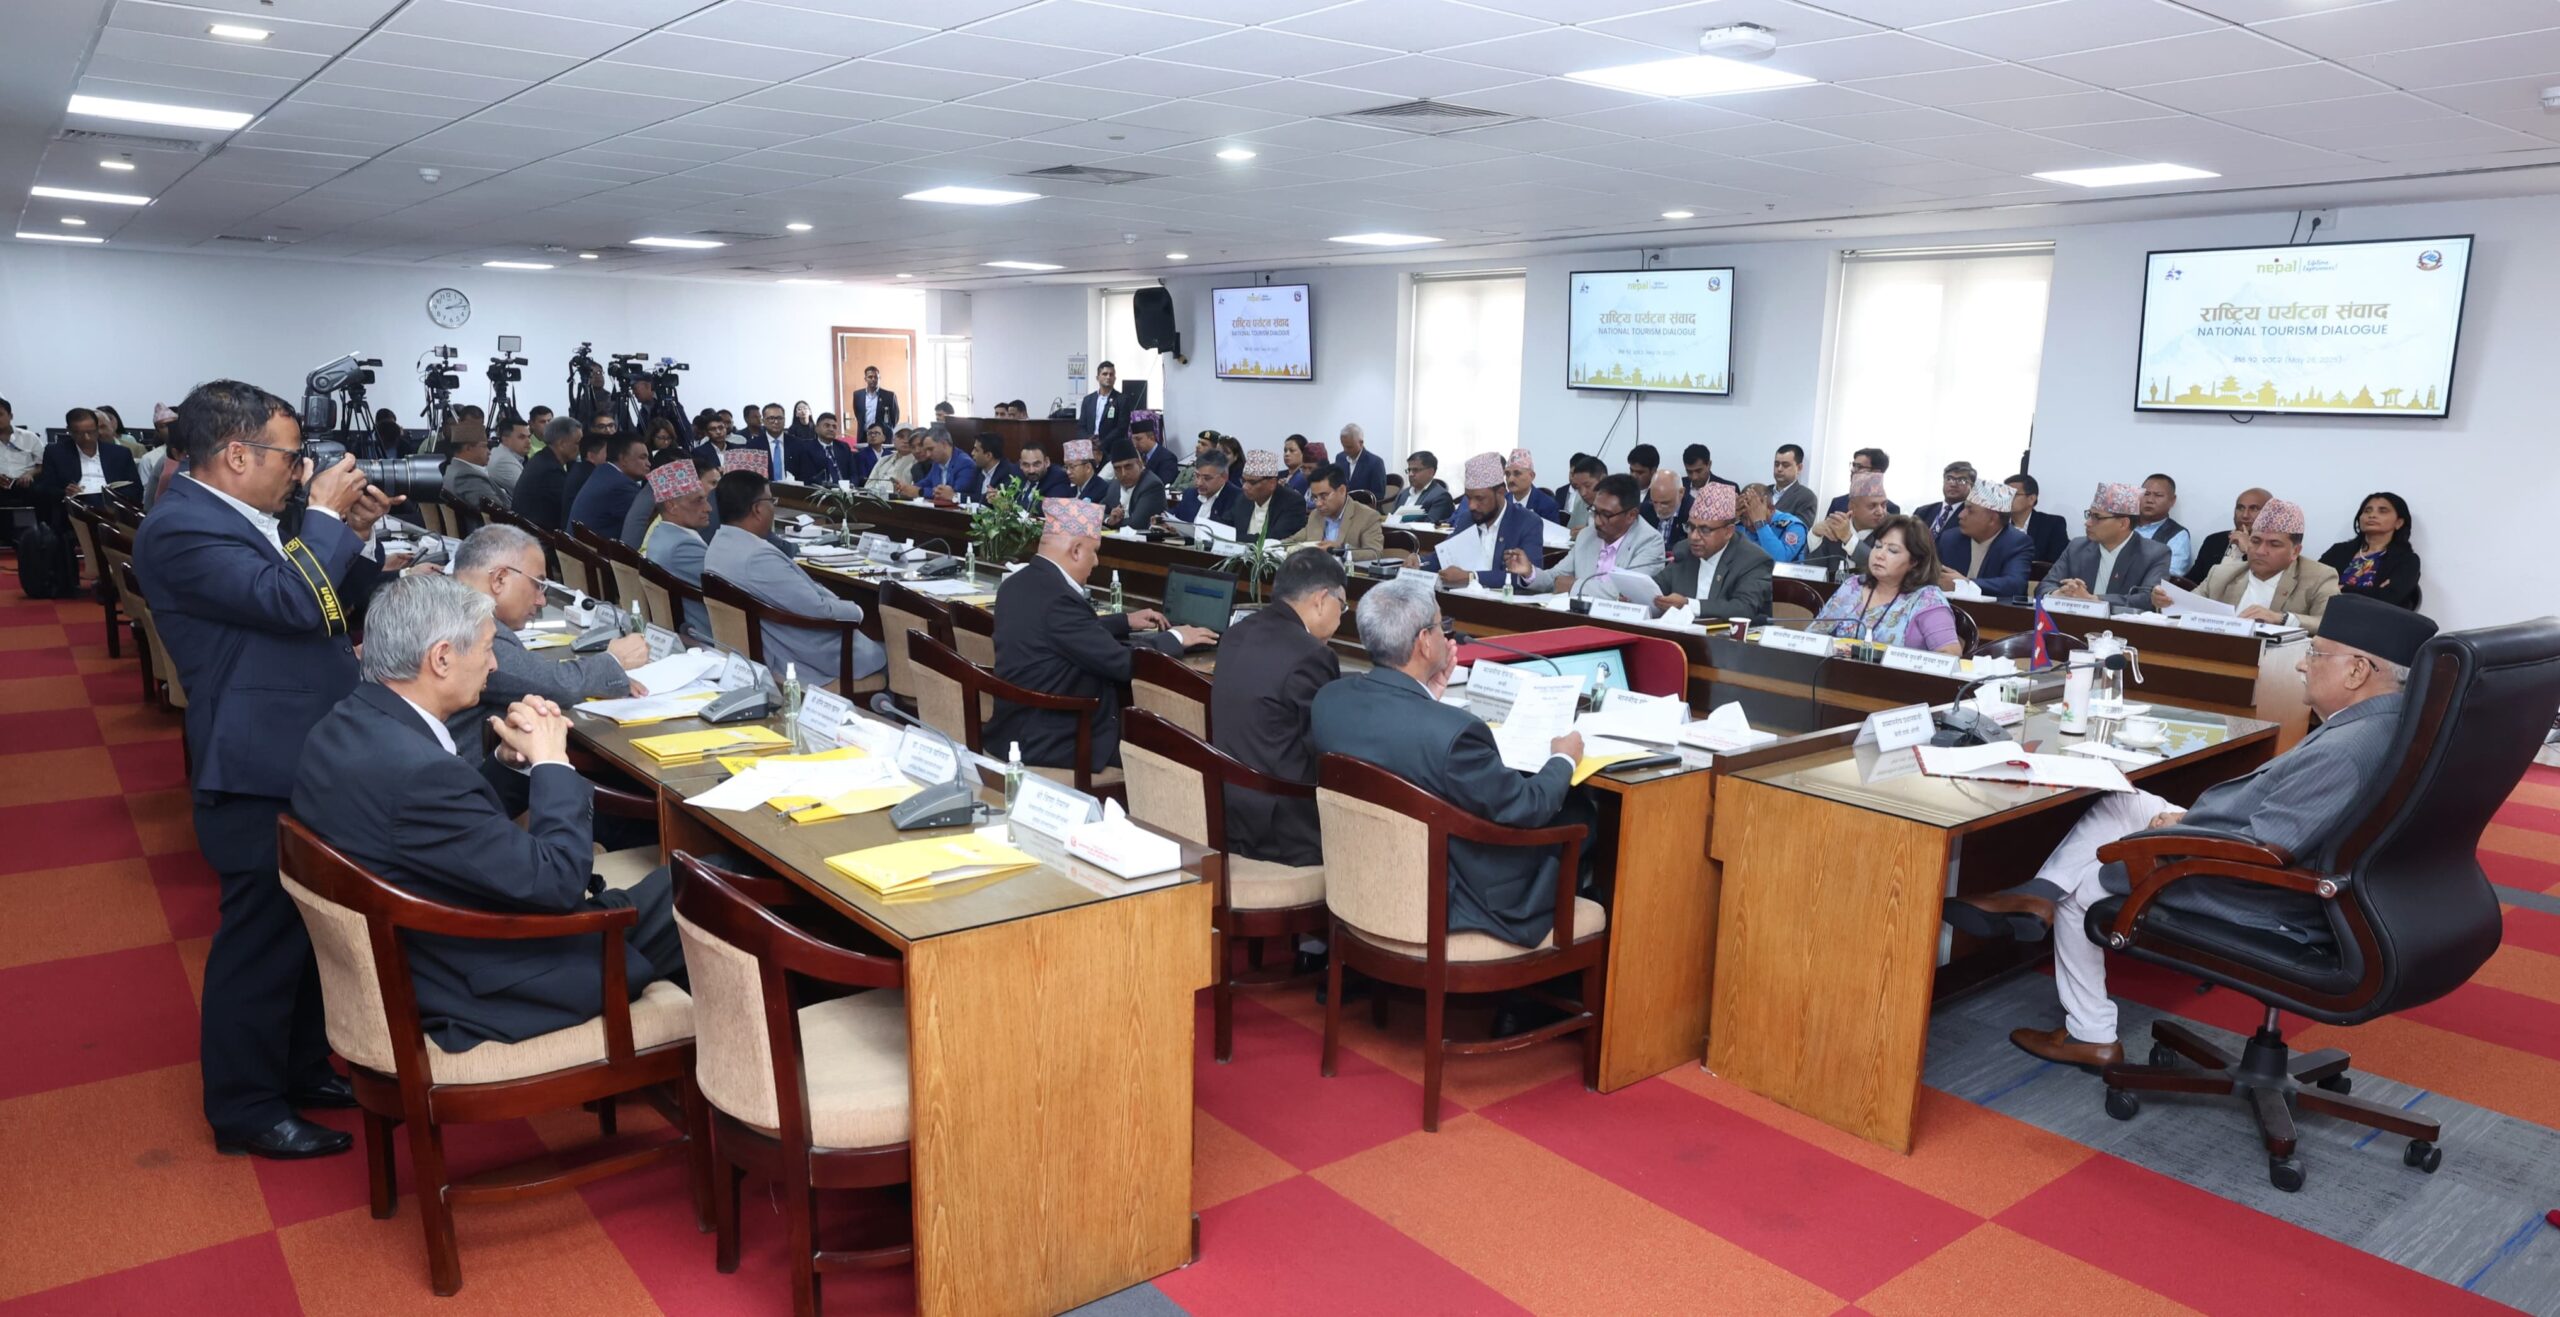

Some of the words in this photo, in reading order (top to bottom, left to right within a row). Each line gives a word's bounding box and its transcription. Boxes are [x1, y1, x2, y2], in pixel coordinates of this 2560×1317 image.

[2257, 260, 2297, 275] nepal
[2200, 302, 2261, 325] राष्ट्रिय
[2268, 301, 2329, 321] पर्यटन
[2336, 301, 2391, 320] संवाद
[1598, 328, 1630, 336] NATIONAL
[1632, 327, 1661, 336] TOURISM
[1663, 327, 1696, 336] DIALOGUE
[2198, 326, 2257, 337] NATIONAL
[2261, 325, 2317, 336] TOURISM
[2321, 324, 2388, 336] DIALOGUE
[321, 586, 340, 620] Nikon
